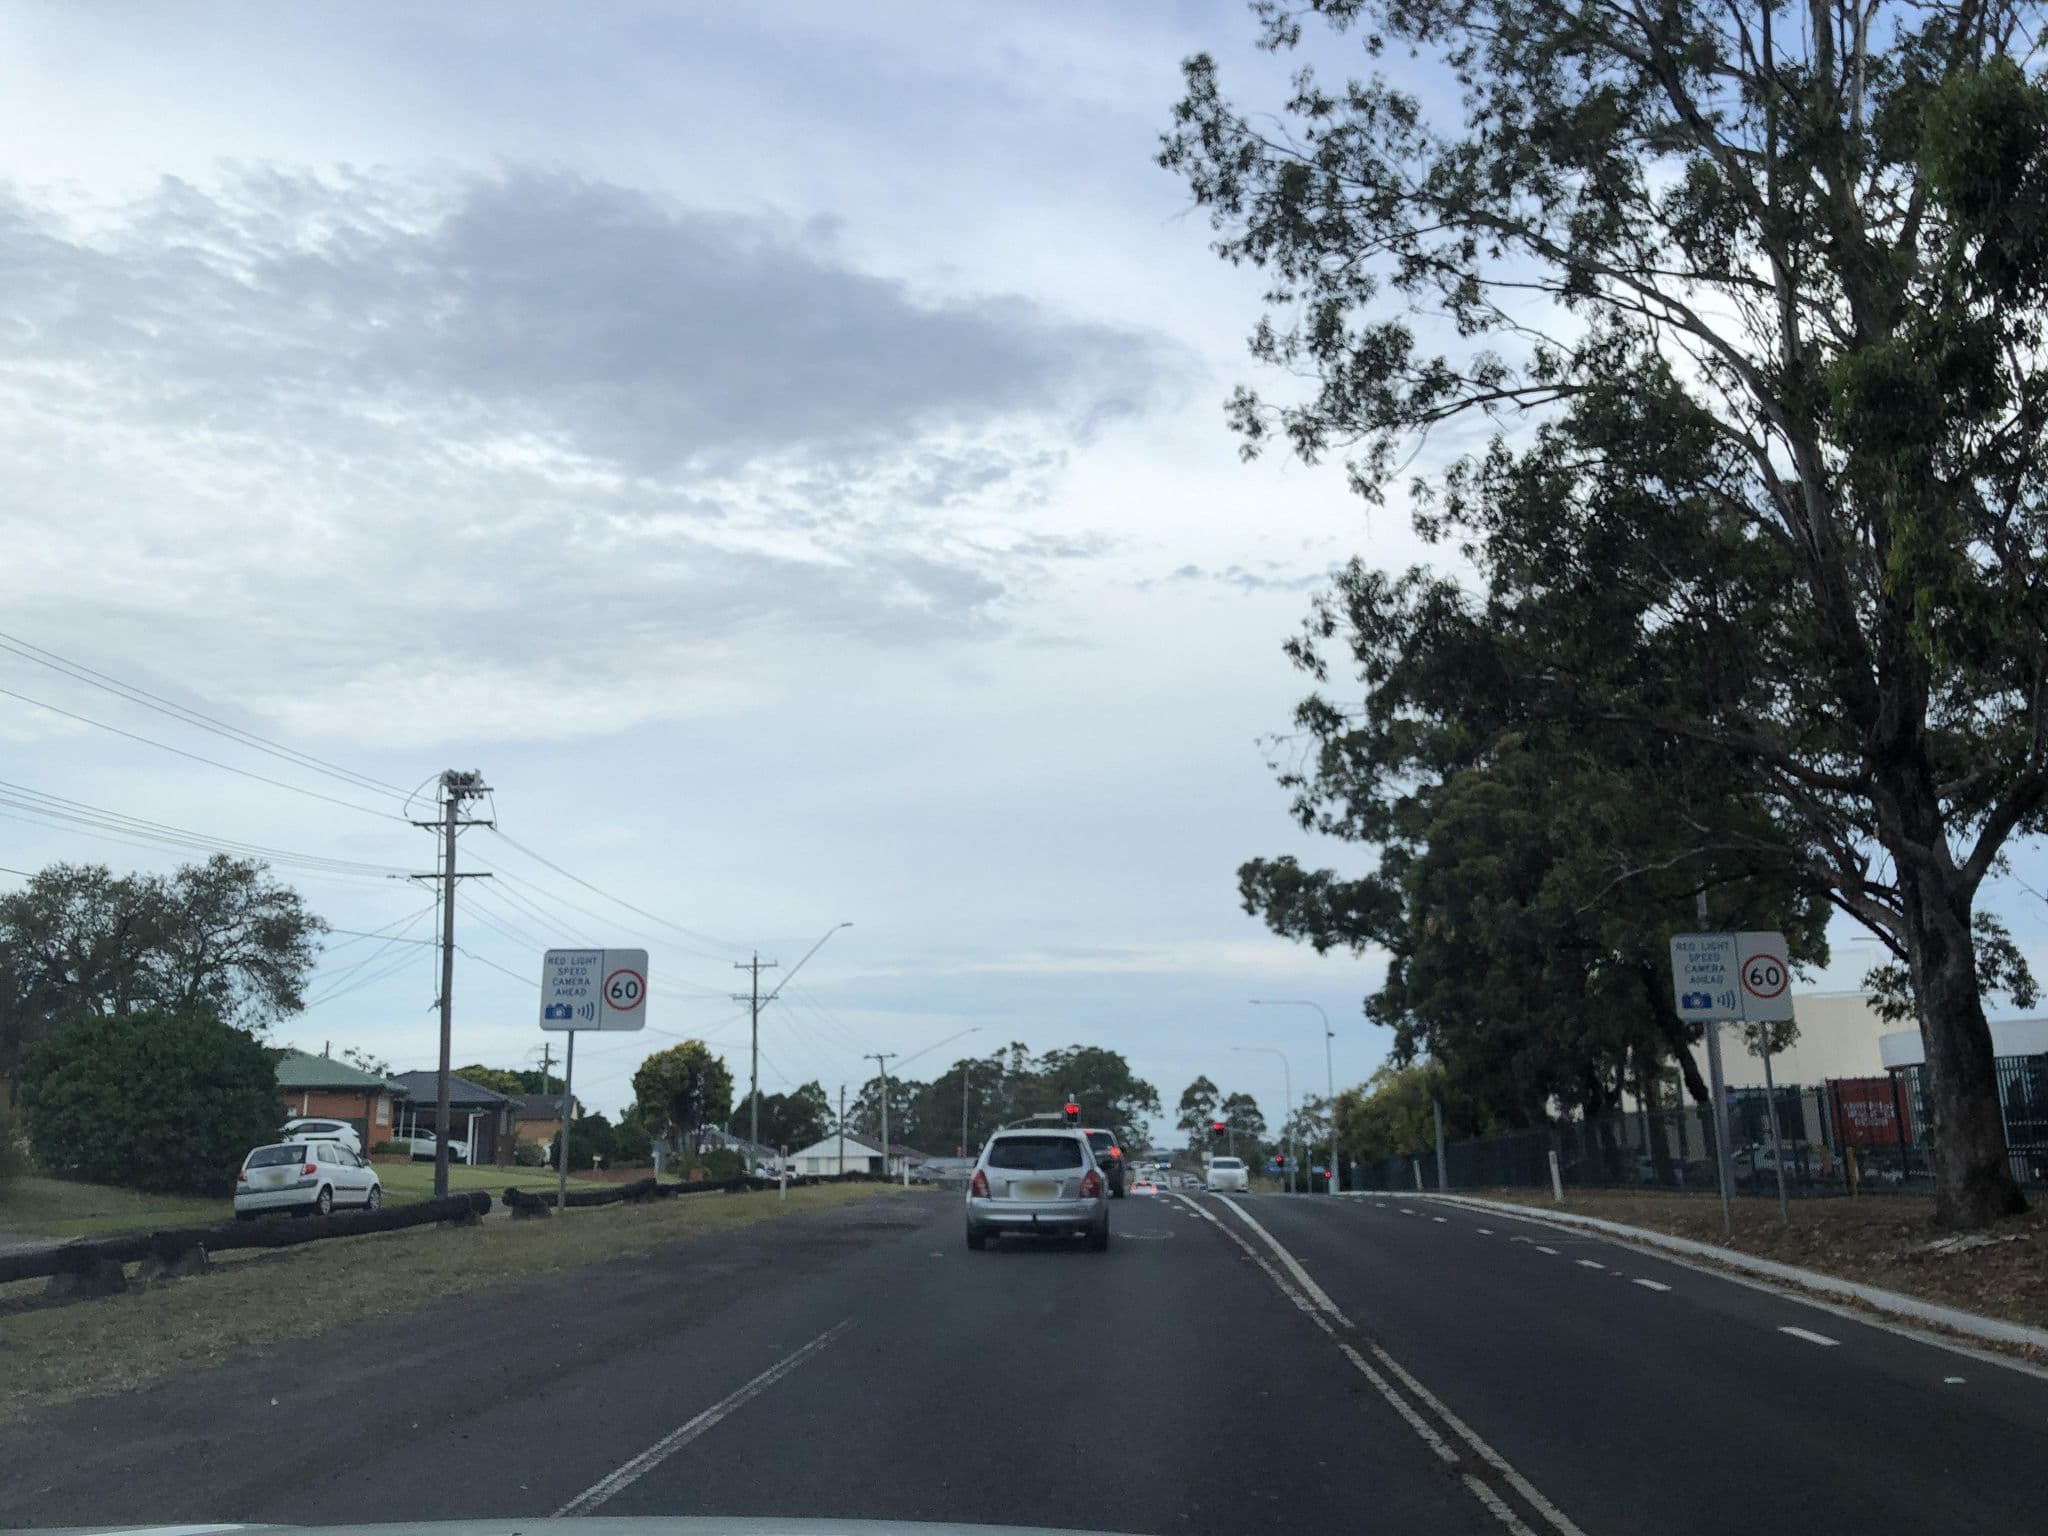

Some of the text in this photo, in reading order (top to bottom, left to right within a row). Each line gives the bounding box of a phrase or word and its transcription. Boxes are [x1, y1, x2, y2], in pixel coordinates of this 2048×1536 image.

[1701, 942, 1729, 951] LIGHT
[548, 956, 597, 965] RED LIGHT
[558, 967, 587, 976] SPEED
[1684, 964, 1725, 973] CAMERA
[1750, 966, 1780, 986] 60
[552, 978, 590, 986] CAMERA
[555, 988, 587, 997] AHEAD
[610, 980, 638, 999] 60
